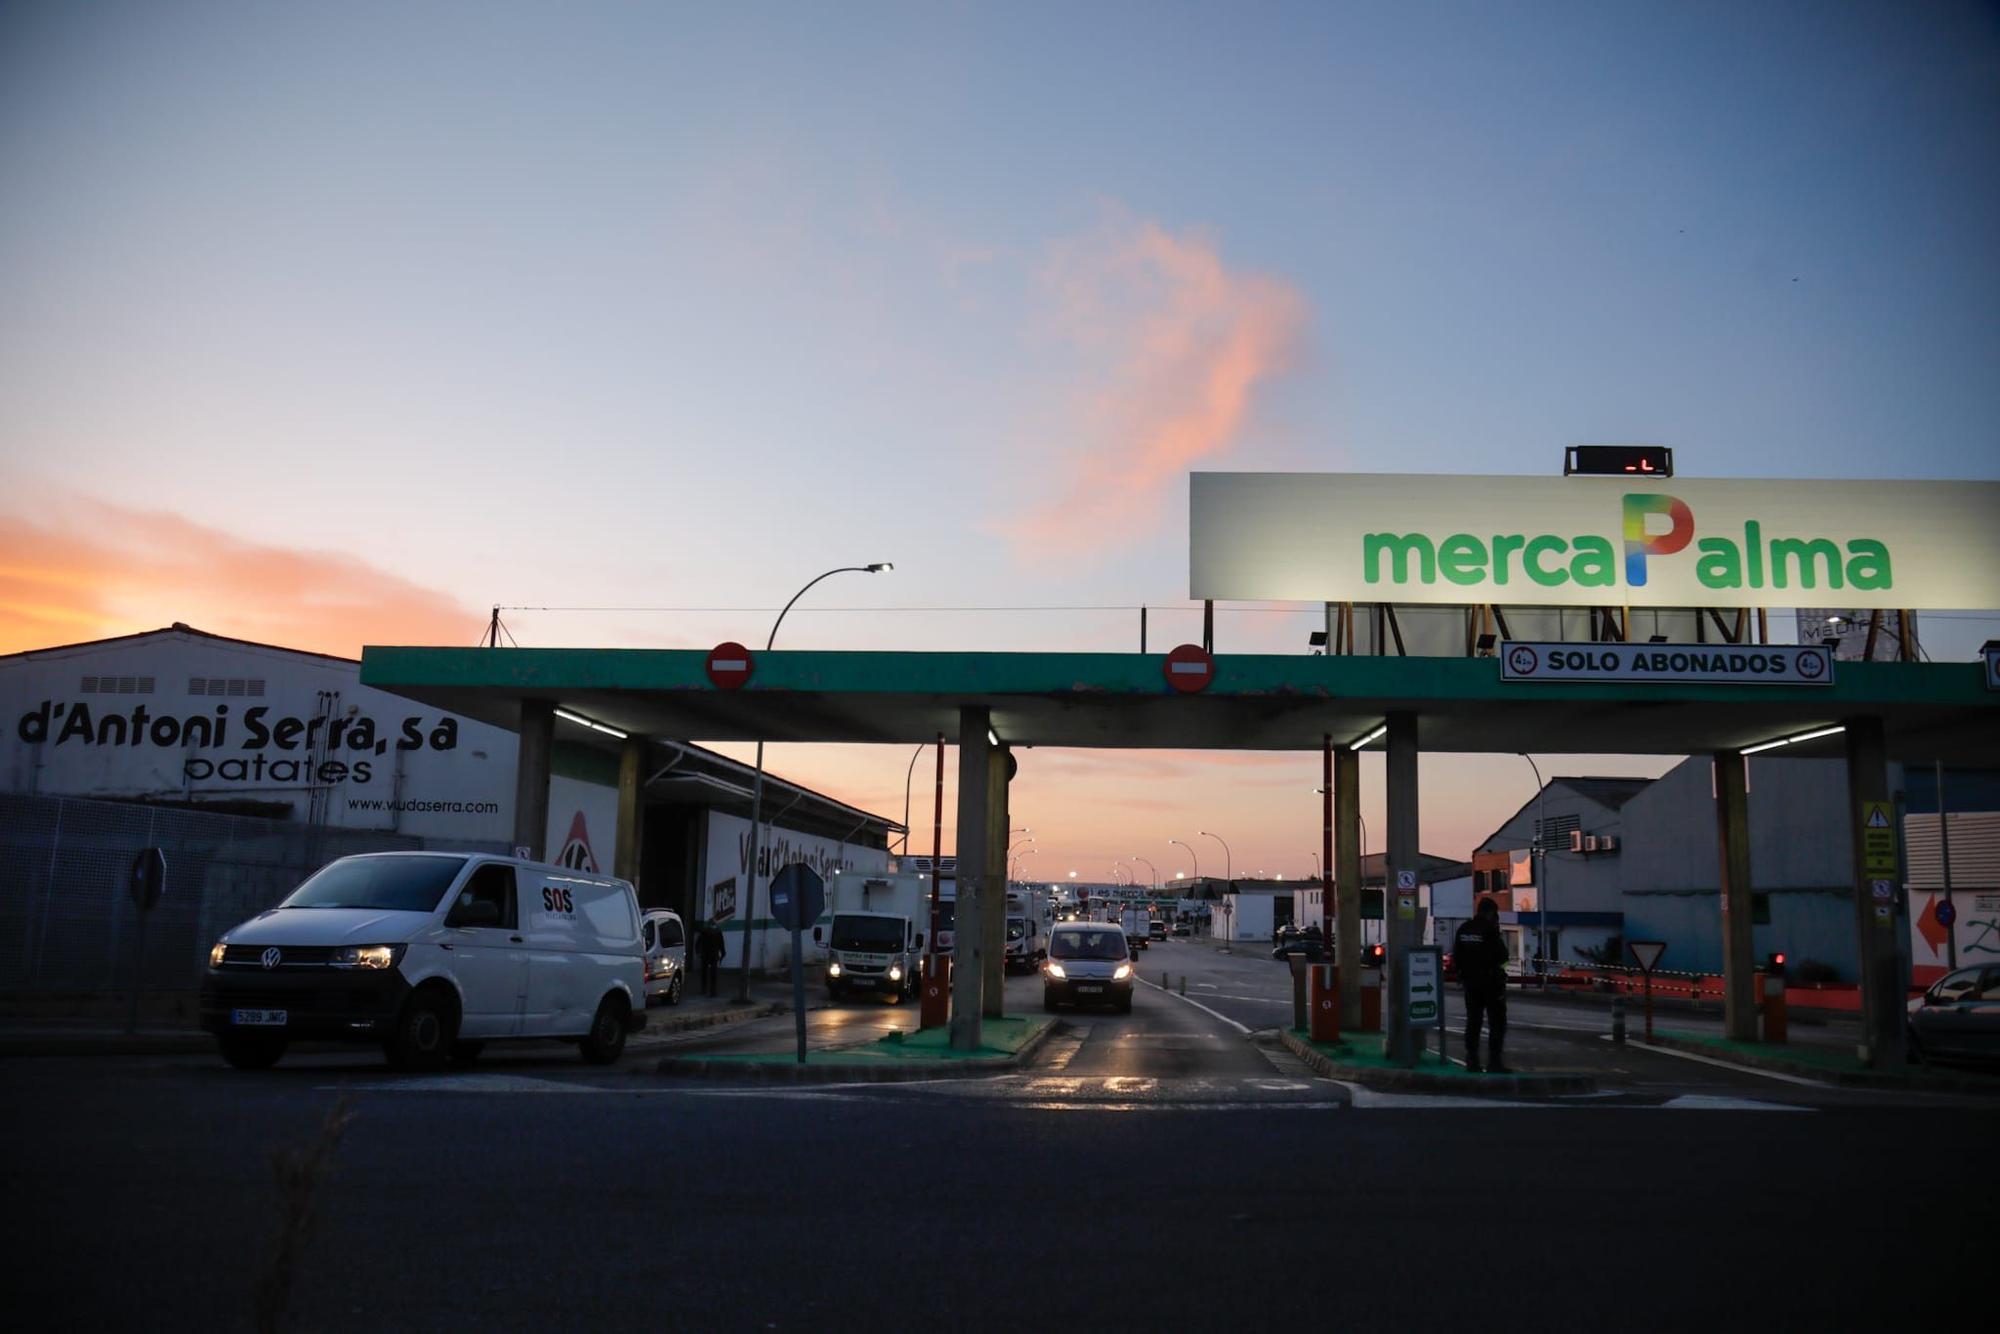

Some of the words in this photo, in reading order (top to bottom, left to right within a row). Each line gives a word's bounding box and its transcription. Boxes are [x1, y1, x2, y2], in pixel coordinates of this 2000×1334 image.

[1363, 493, 1893, 590] mercaPalma
[1547, 650, 1620, 672] SOLO
[1631, 653, 1786, 674] ABONADOS
[18, 700, 228, 748] d'Antoni
[242, 706, 387, 756] Serra,
[396, 717, 458, 751] sa
[183, 753, 372, 786] patates
[542, 887, 574, 913] SOS
